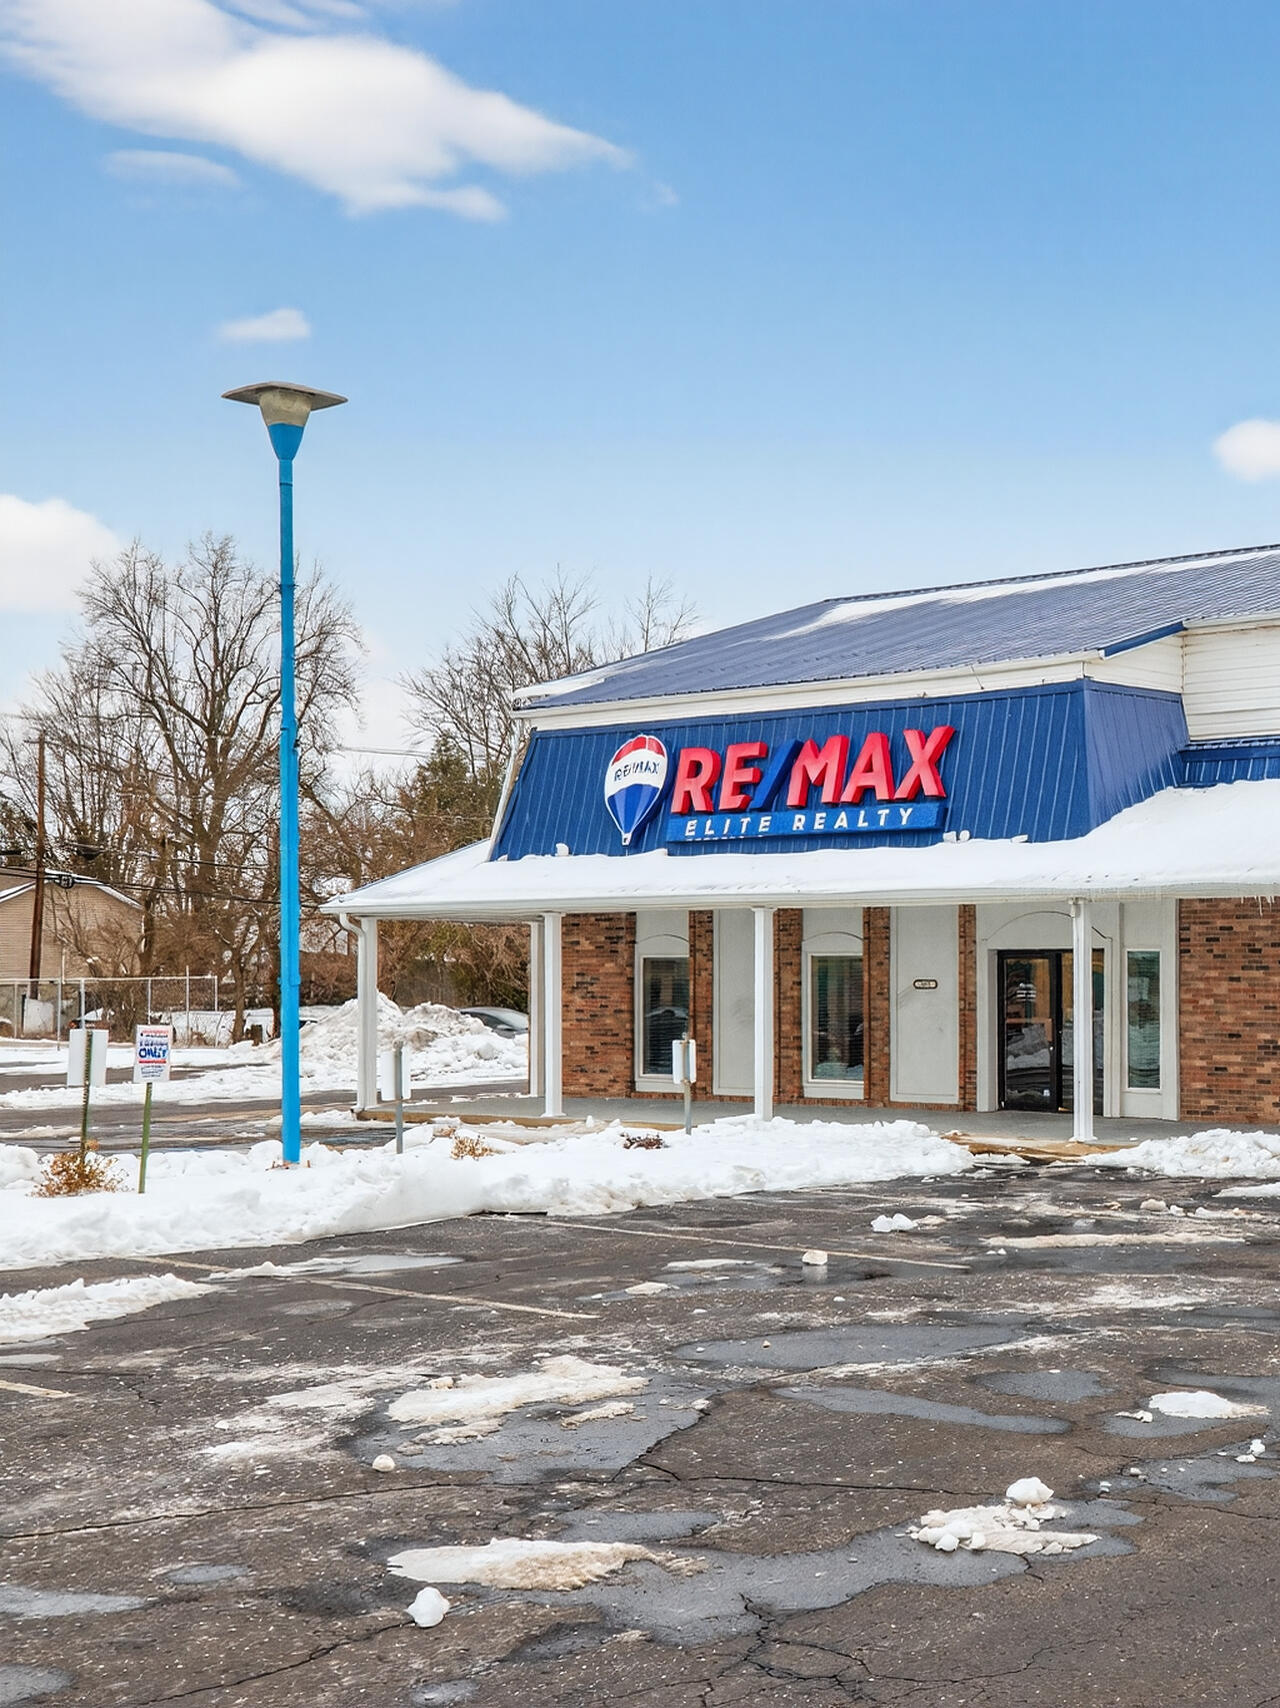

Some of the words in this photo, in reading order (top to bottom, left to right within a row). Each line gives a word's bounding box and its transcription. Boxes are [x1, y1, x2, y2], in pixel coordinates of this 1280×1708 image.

[670, 725, 955, 815] RE/MAX
[685, 816, 772, 836] ELITE
[792, 807, 913, 831] REALTY
